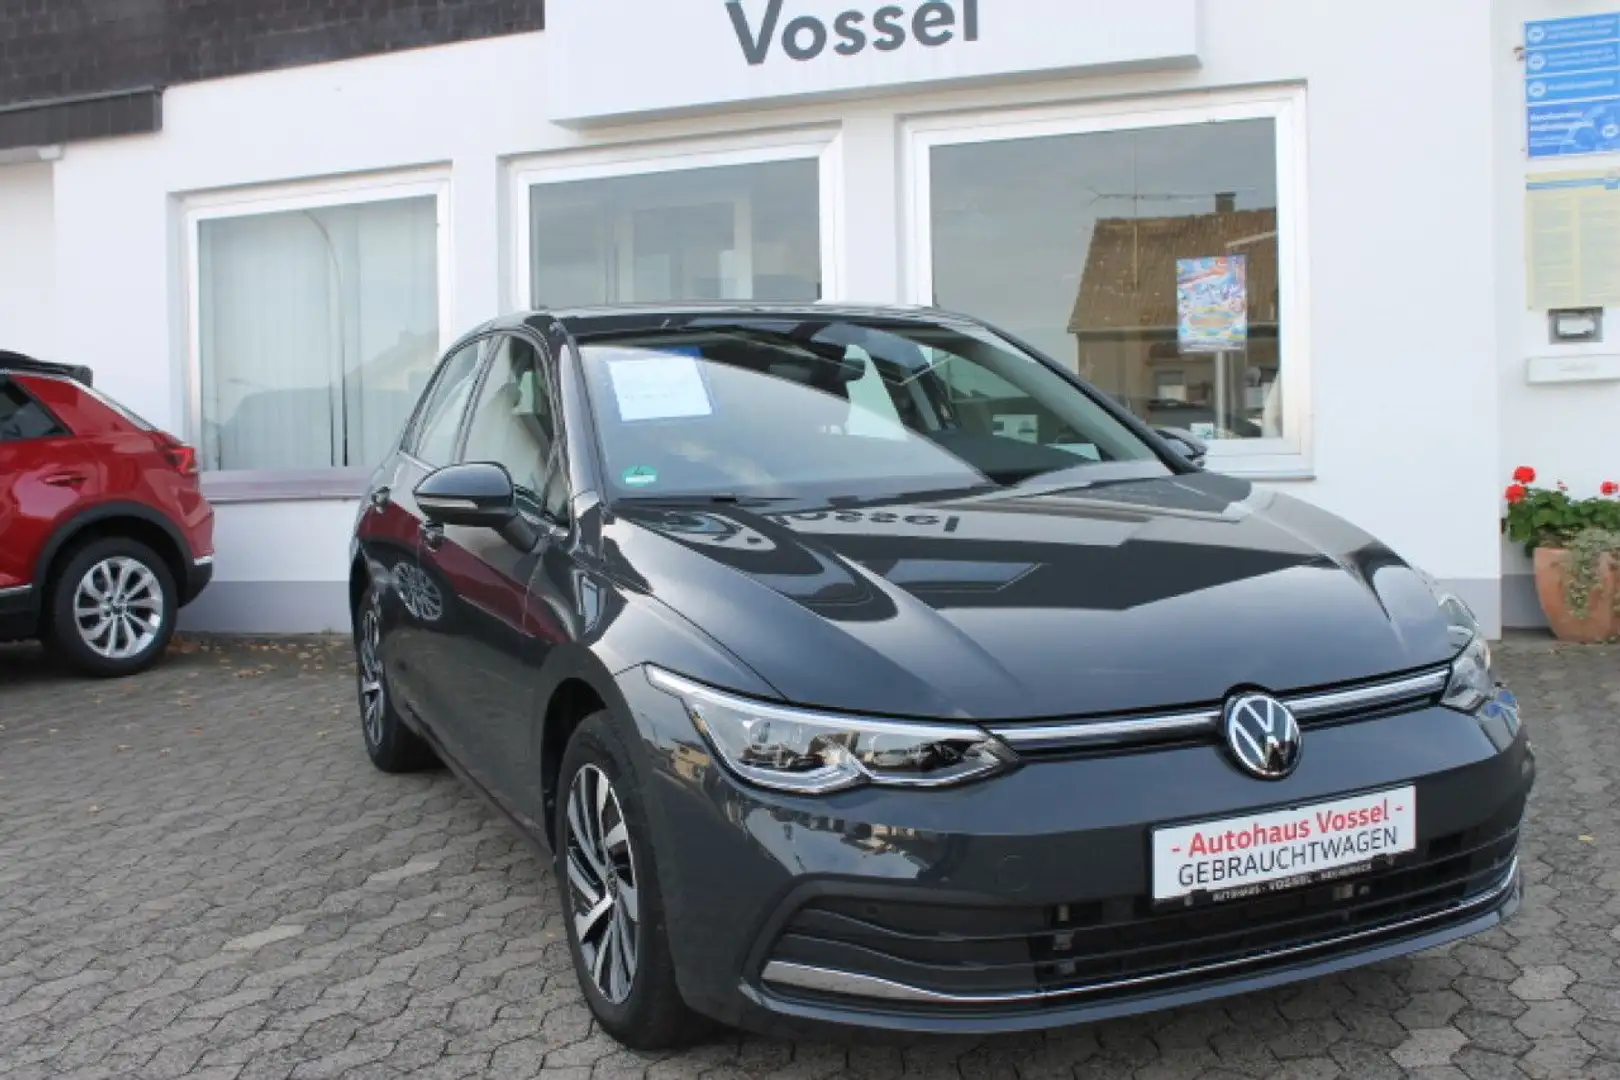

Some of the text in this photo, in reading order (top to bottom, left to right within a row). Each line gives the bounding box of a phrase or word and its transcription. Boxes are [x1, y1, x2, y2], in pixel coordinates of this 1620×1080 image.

[725, 0, 979, 66] Vossel
[1179, 825, 1398, 887] GEBRAUCHTWAGEN
[1188, 819, 1311, 858] Autohaus
[1316, 797, 1390, 834] Vossel
